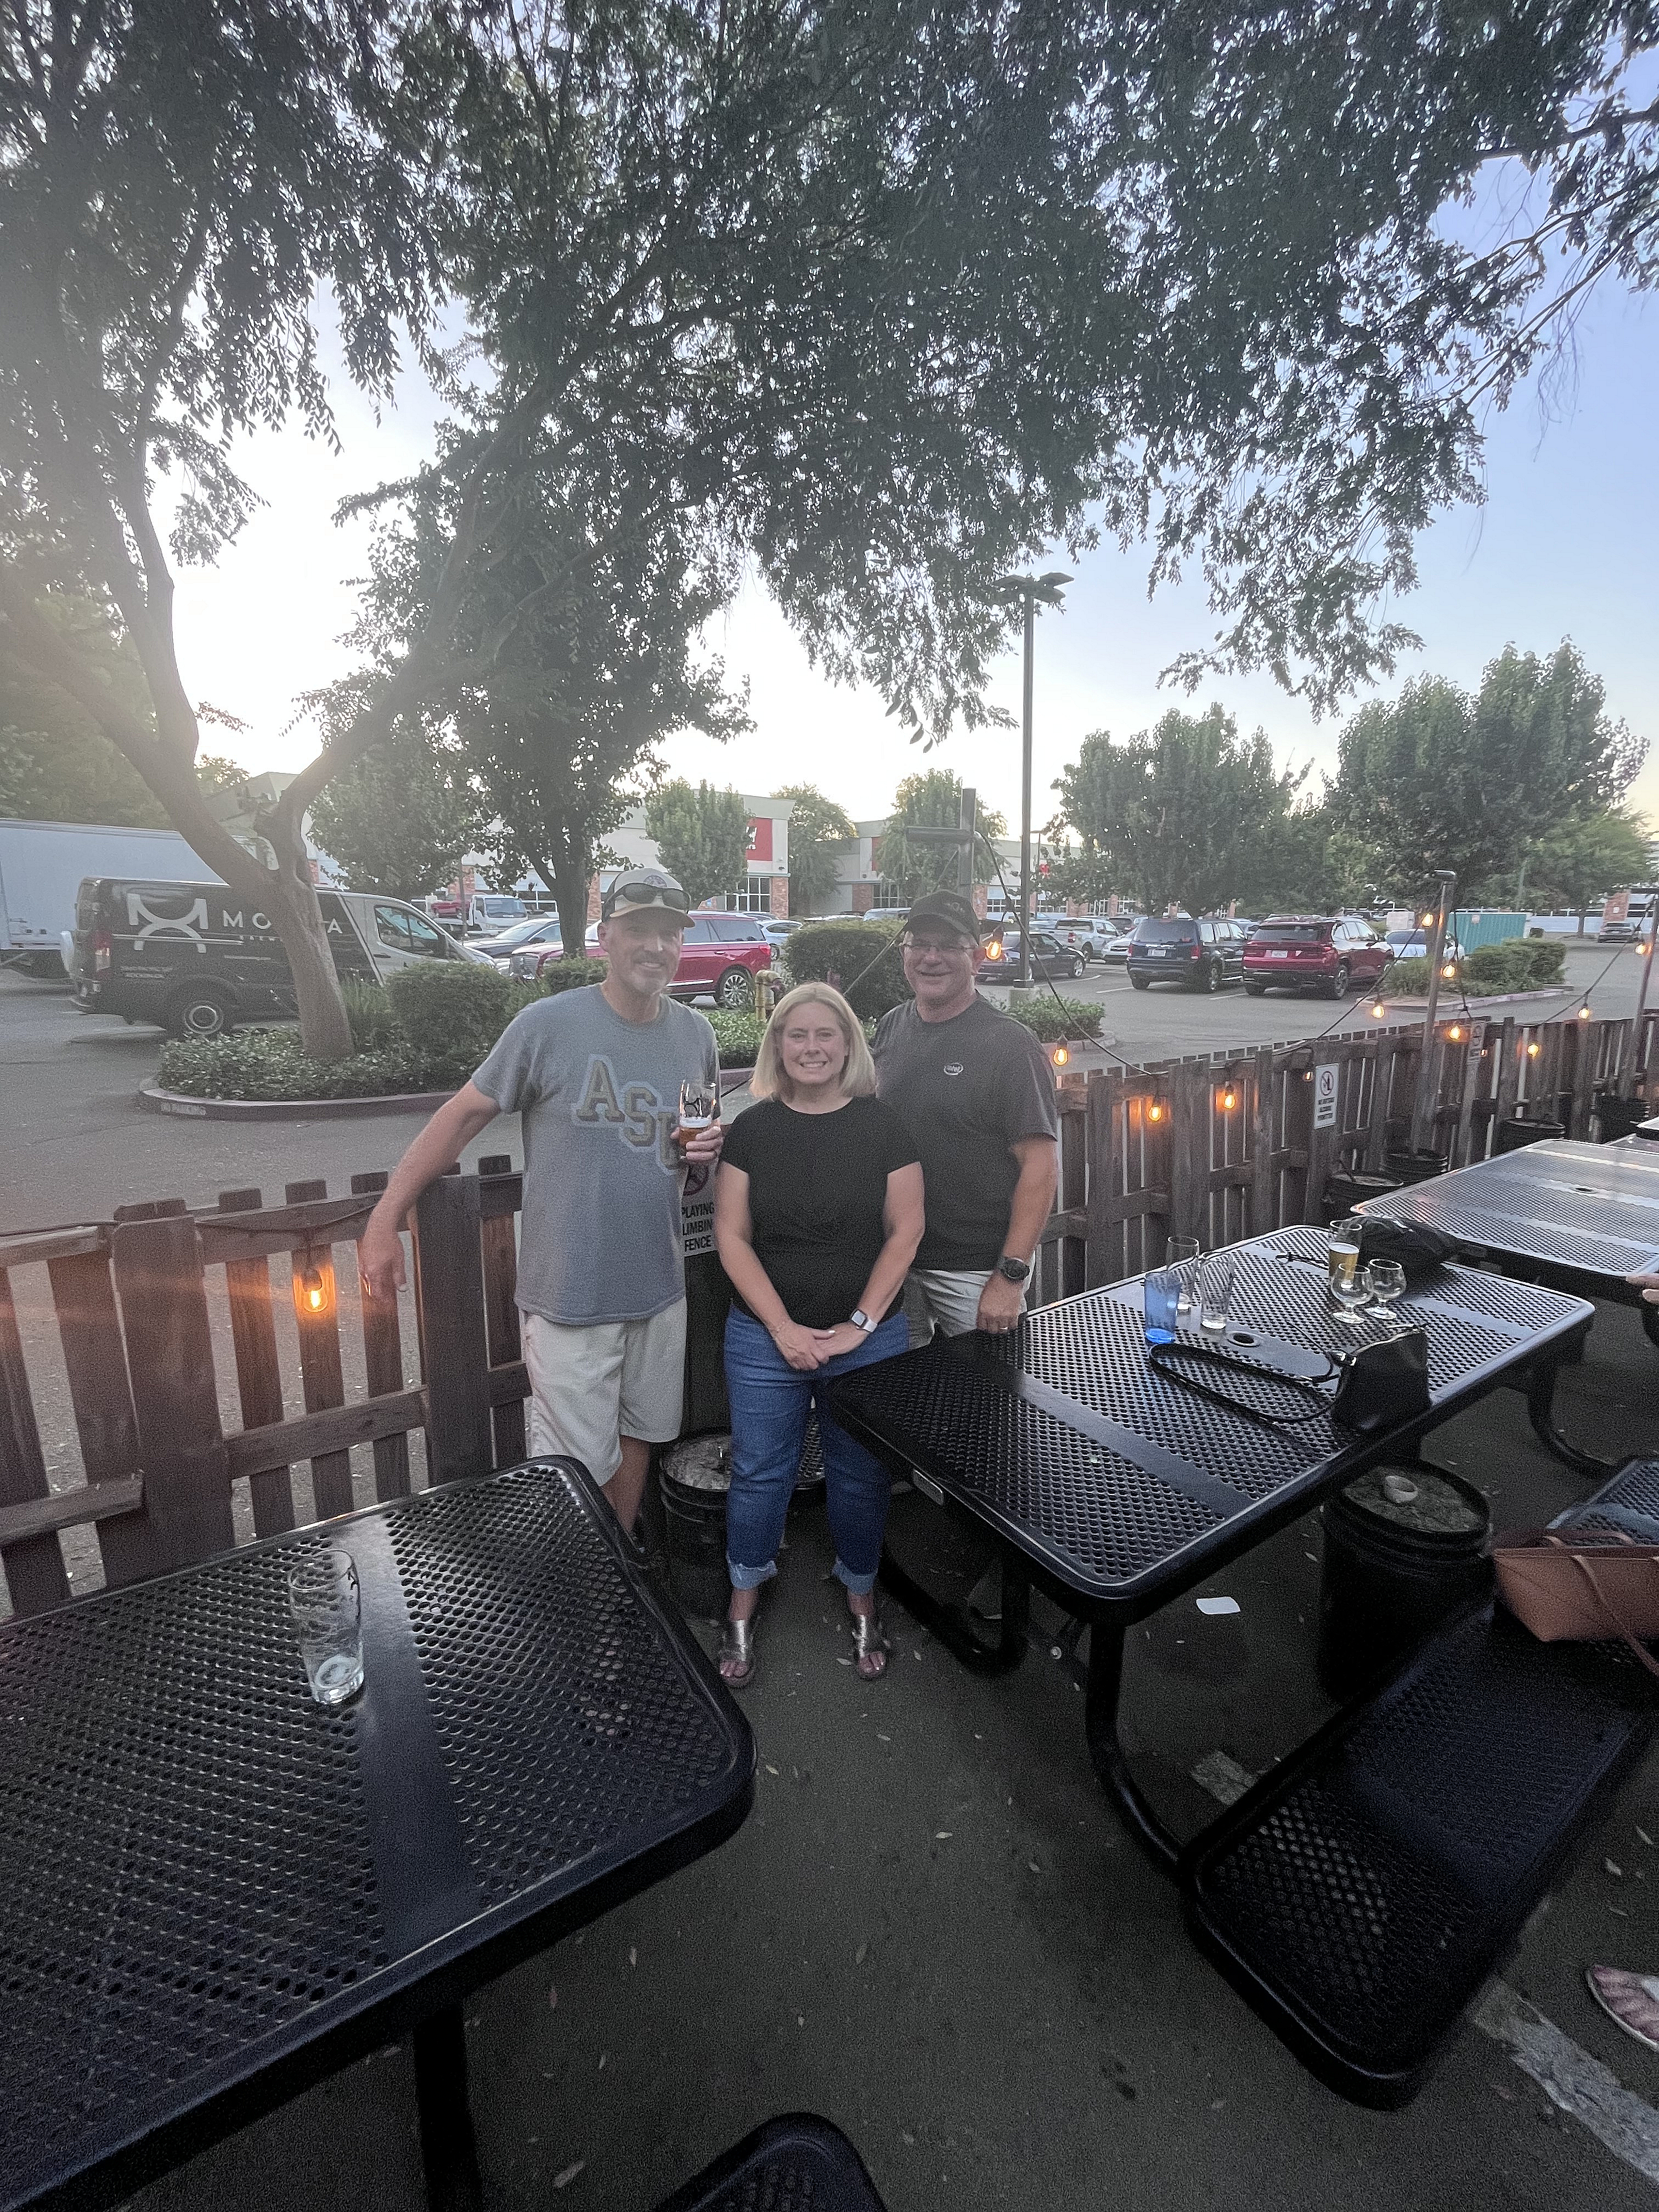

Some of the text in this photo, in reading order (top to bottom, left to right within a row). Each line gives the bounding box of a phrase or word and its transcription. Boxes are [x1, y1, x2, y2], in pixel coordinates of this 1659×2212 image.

[223, 910, 343, 934] MOA
[682, 1220, 712, 1235] LIMBIN
[685, 1235, 712, 1252] FENCE
